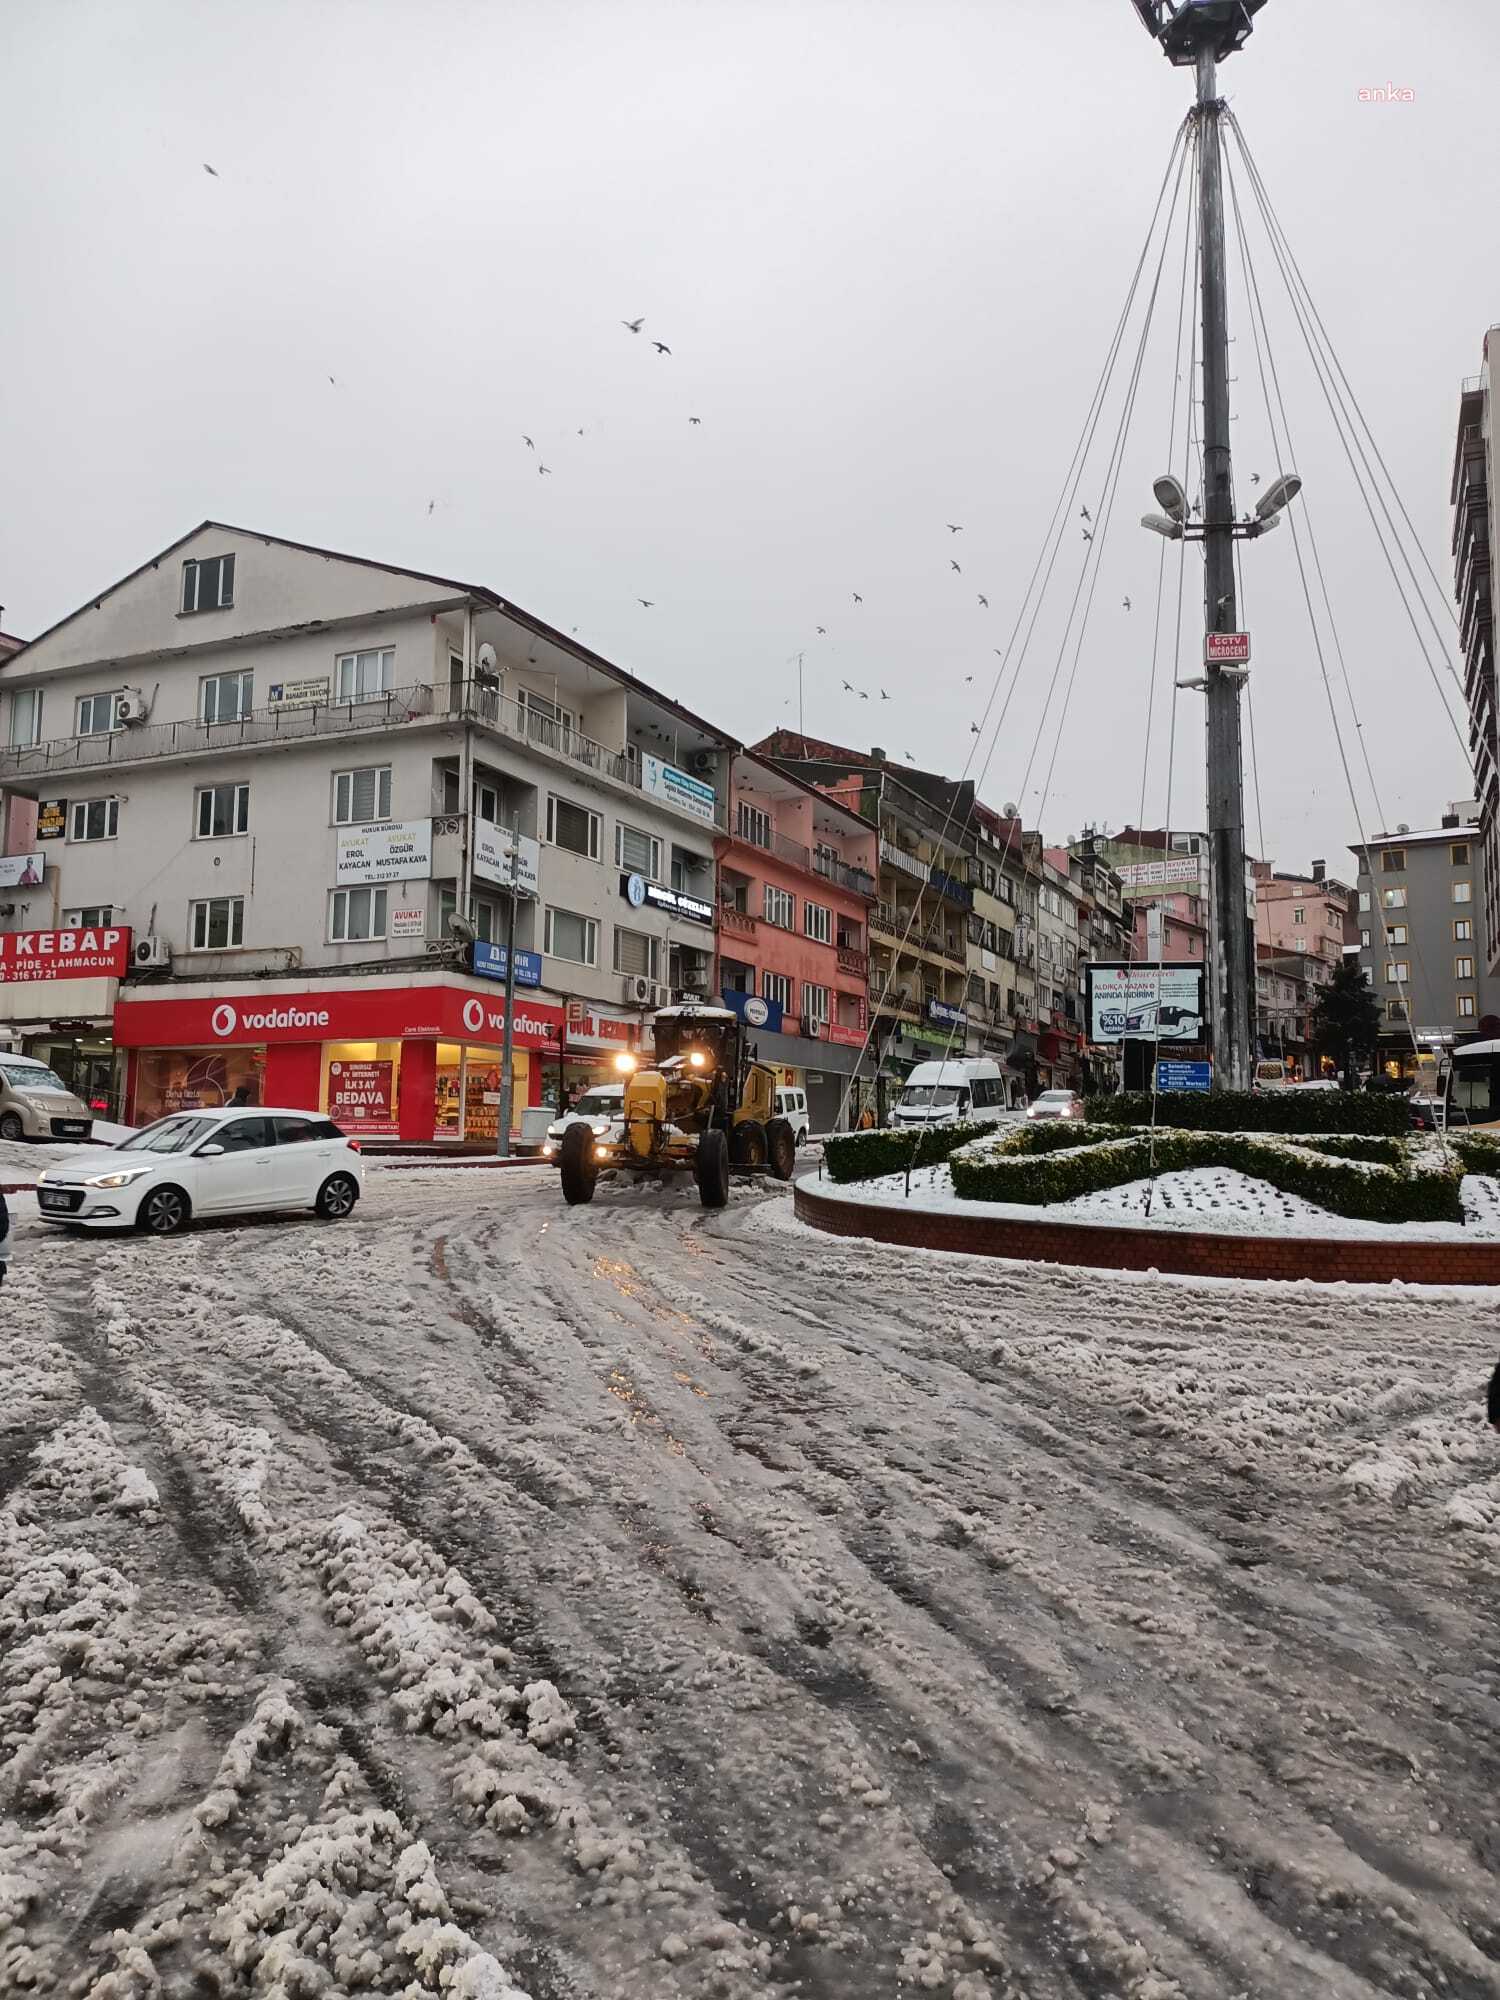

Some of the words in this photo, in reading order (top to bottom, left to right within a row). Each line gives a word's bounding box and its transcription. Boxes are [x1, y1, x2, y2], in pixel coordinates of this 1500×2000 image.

[1214, 637, 1242, 645] CCTV
[346, 850, 364, 858] EROL
[389, 844, 414, 854] ÖZGÜR
[339, 861, 371, 870] KAYACAN
[376, 858, 408, 867] MUSTAFA
[408, 855, 427, 864] KAYA
[394, 911, 421, 919] AVUKAT
[16, 930, 120, 955] KEBAP
[16, 958, 41, 970] PİDE
[51, 956, 115, 968] LAHMACUN
[12, 971, 30, 981] 316
[32, 970, 43, 979] 17
[45, 969, 57, 979] 21
[1094, 983, 1123, 991] ALDIKÇA
[1094, 991, 1122, 999] ANINDA
[242, 1007, 329, 1029] vodafone
[1102, 1014, 1125, 1026] %10
[345, 1079, 357, 1089] İLK
[365, 1080, 375, 1088] AY
[336, 1092, 384, 1104] BEDAVA
